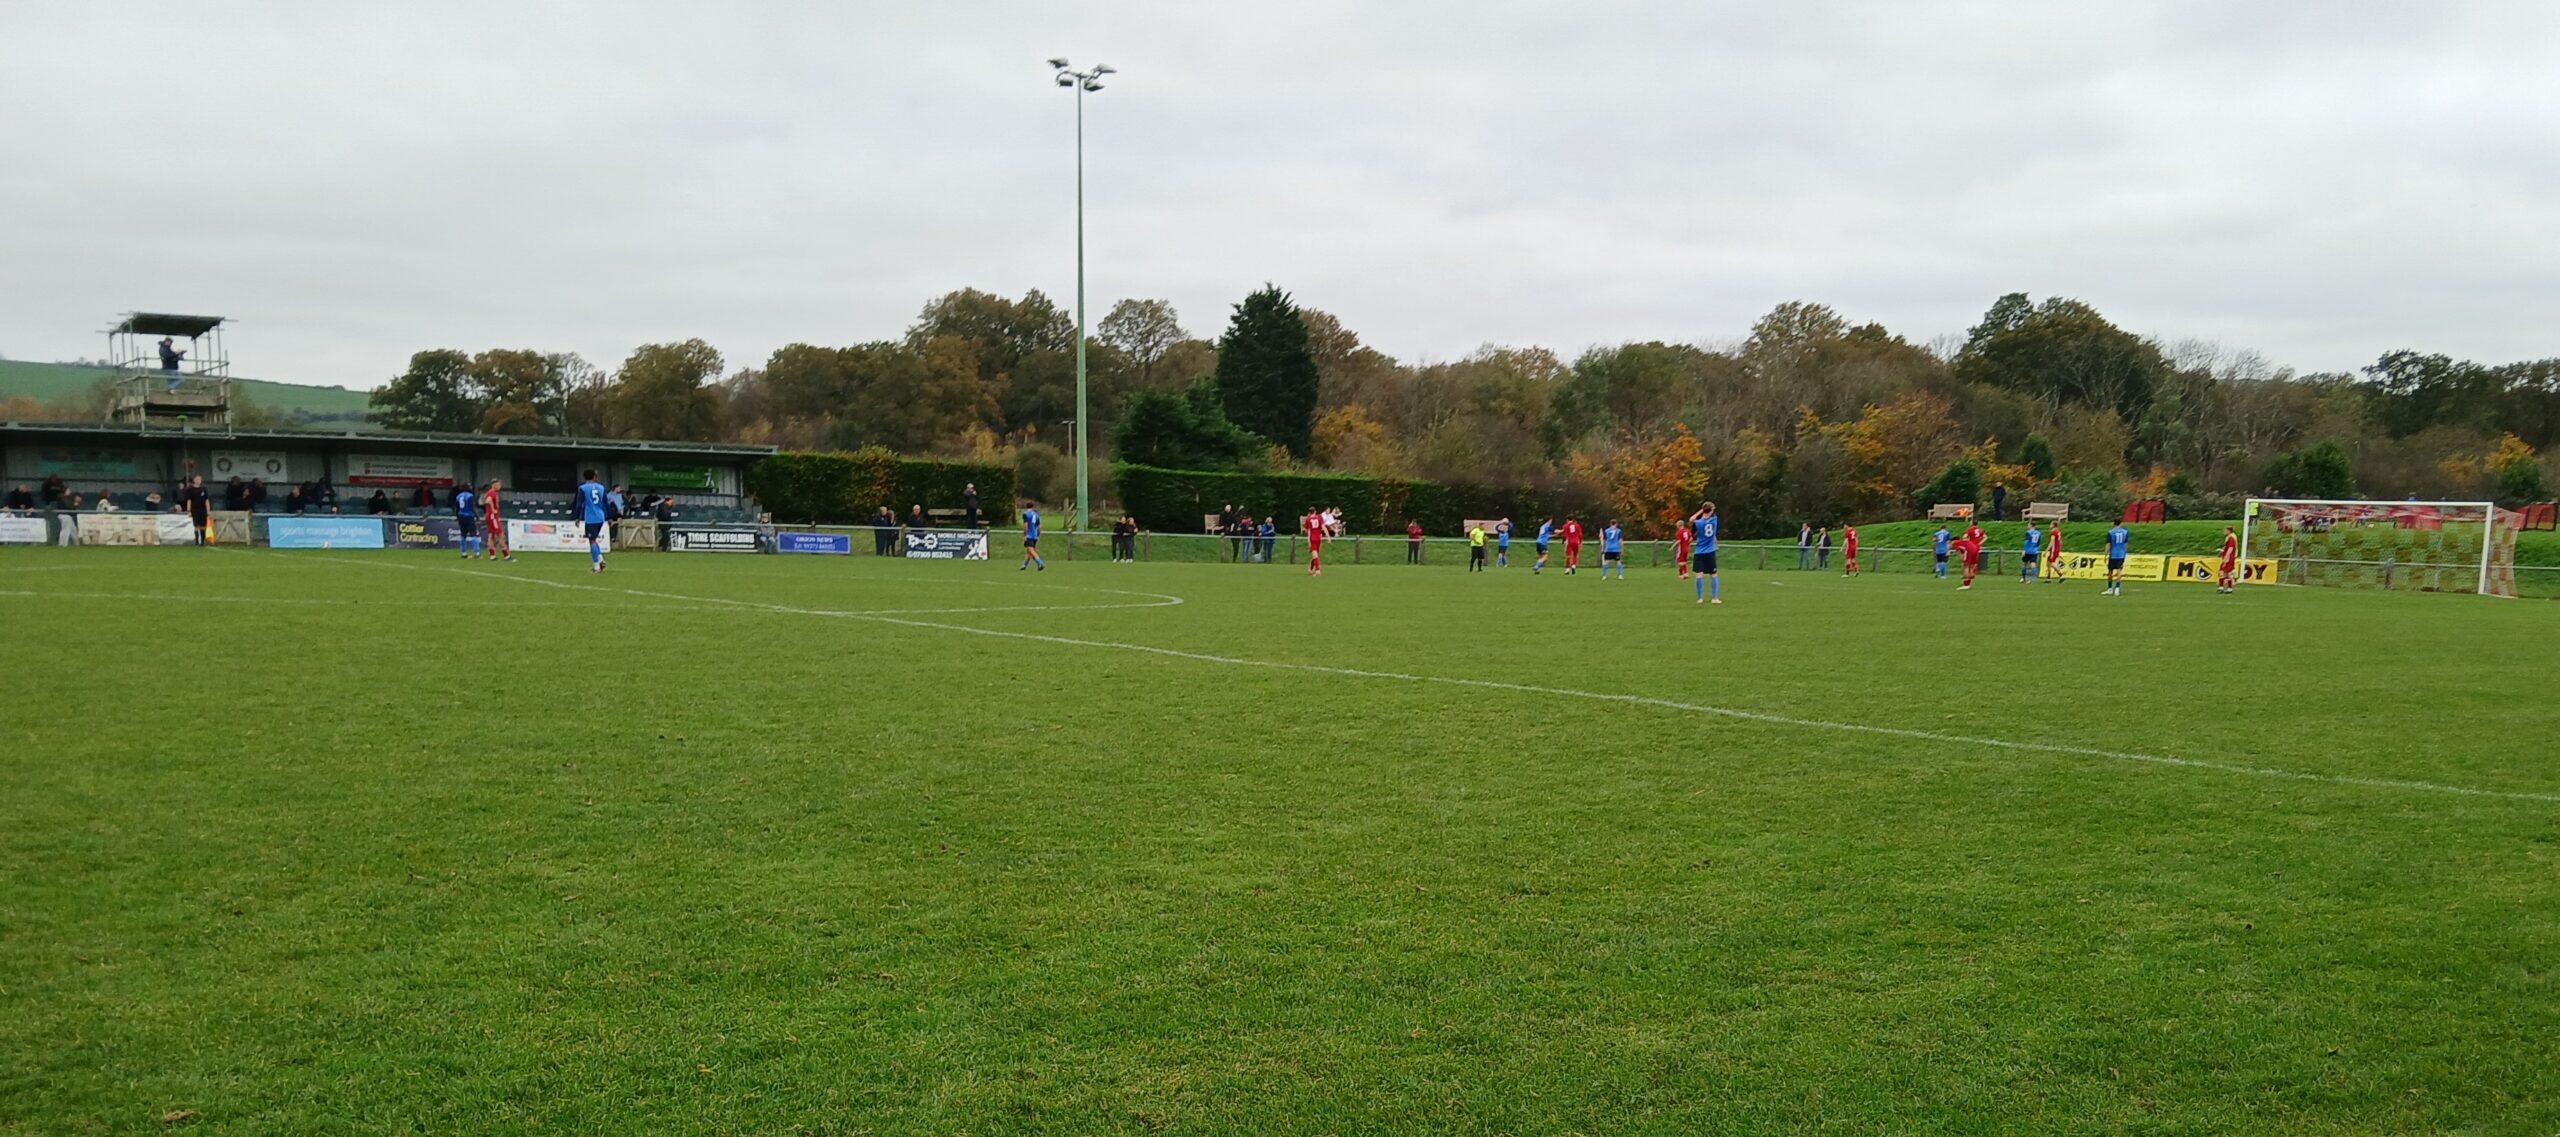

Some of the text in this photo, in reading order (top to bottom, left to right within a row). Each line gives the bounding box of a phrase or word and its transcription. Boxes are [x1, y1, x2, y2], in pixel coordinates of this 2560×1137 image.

[592, 489, 599, 504] 5
[459, 496, 465, 509] 6
[1310, 518, 1319, 528] 10
[1610, 531, 1616, 539] 7
[1704, 523, 1714, 537] 8
[1974, 528, 1980, 538] 5
[400, 533, 438, 545] Contracting
[709, 533, 755, 543] SCAFFOLDING
[2115, 533, 2122, 544] 11
